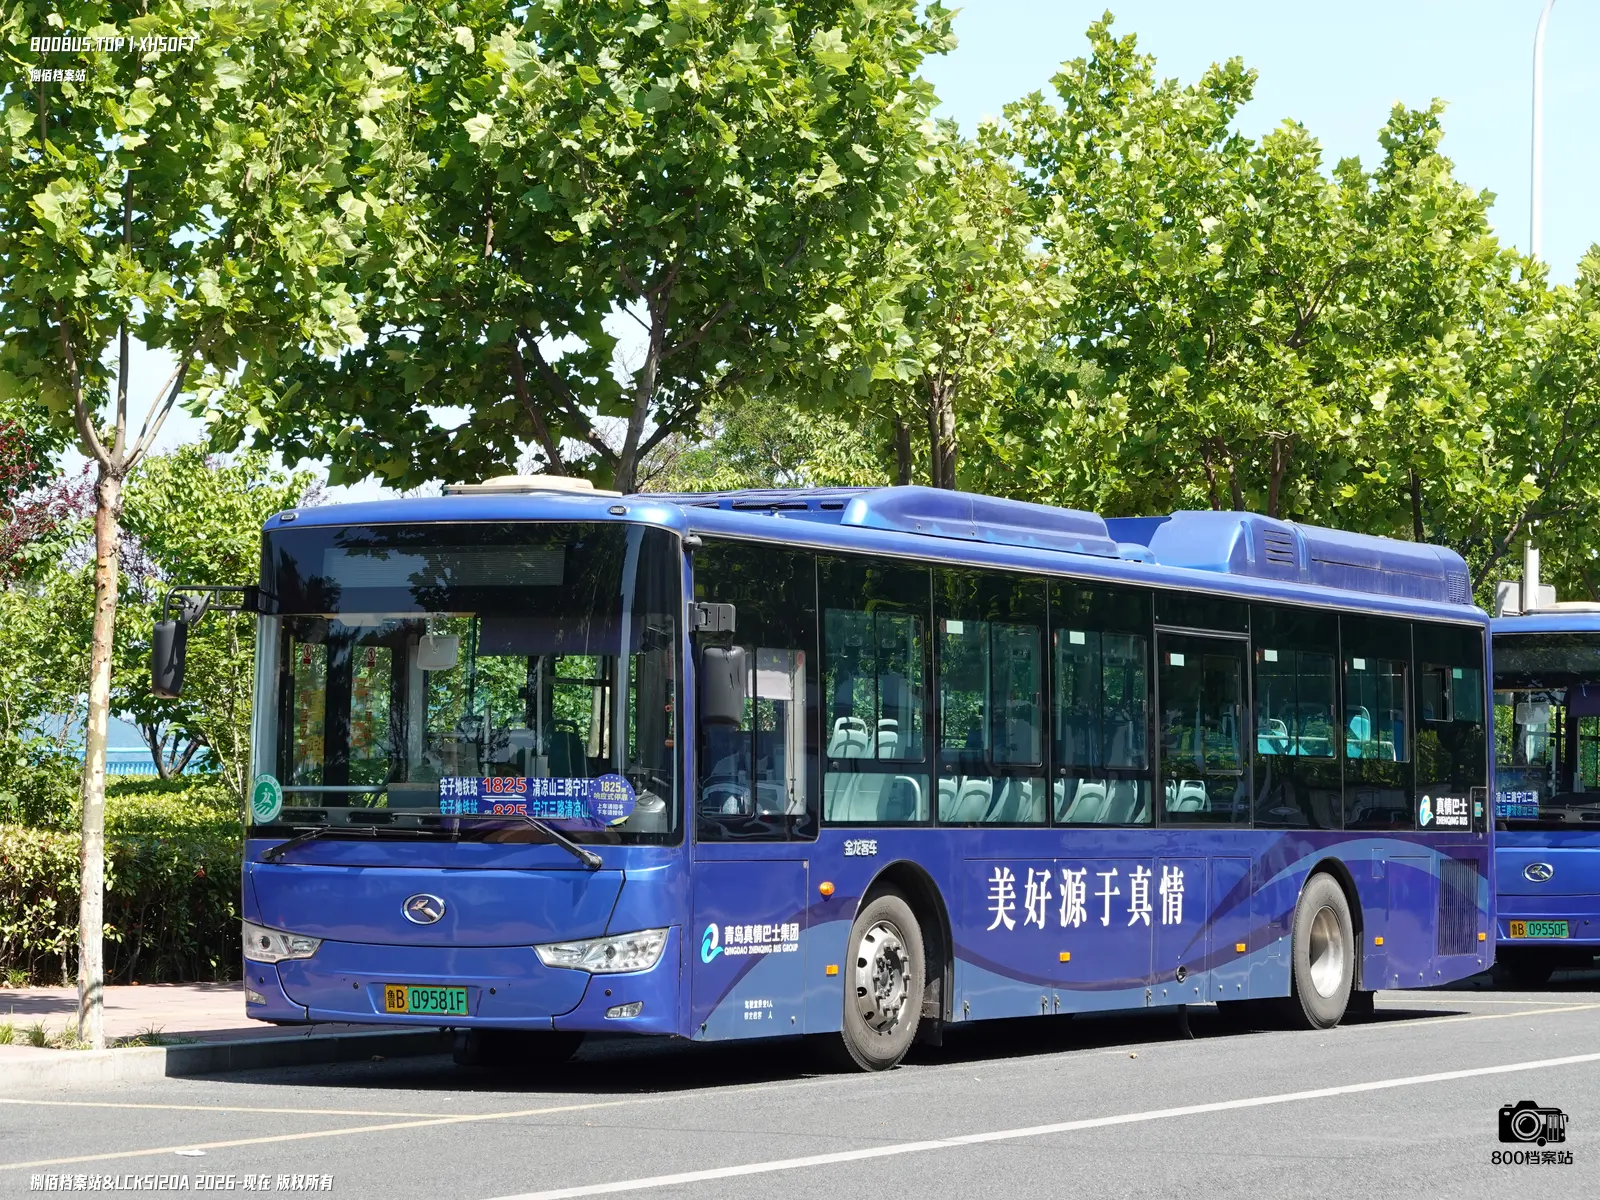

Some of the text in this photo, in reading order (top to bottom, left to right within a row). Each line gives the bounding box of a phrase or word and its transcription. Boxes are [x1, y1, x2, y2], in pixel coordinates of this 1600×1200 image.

[439, 777, 478, 796] 安子地铁站
[482, 776, 527, 794] 1825
[532, 778, 595, 797] 清凉山三路宁江
[493, 803, 528, 816] 825
[1436, 797, 1468, 815] 真情巴士
[1436, 816, 1468, 825] ZHENQING BUS
[843, 838, 878, 856] 金龙客车
[986, 864, 1185, 931] 美好源于真情
[724, 922, 799, 945] 青岛真情巴士集团
[724, 943, 799, 956] QINGDAO ZHENQING BUS GROUP
